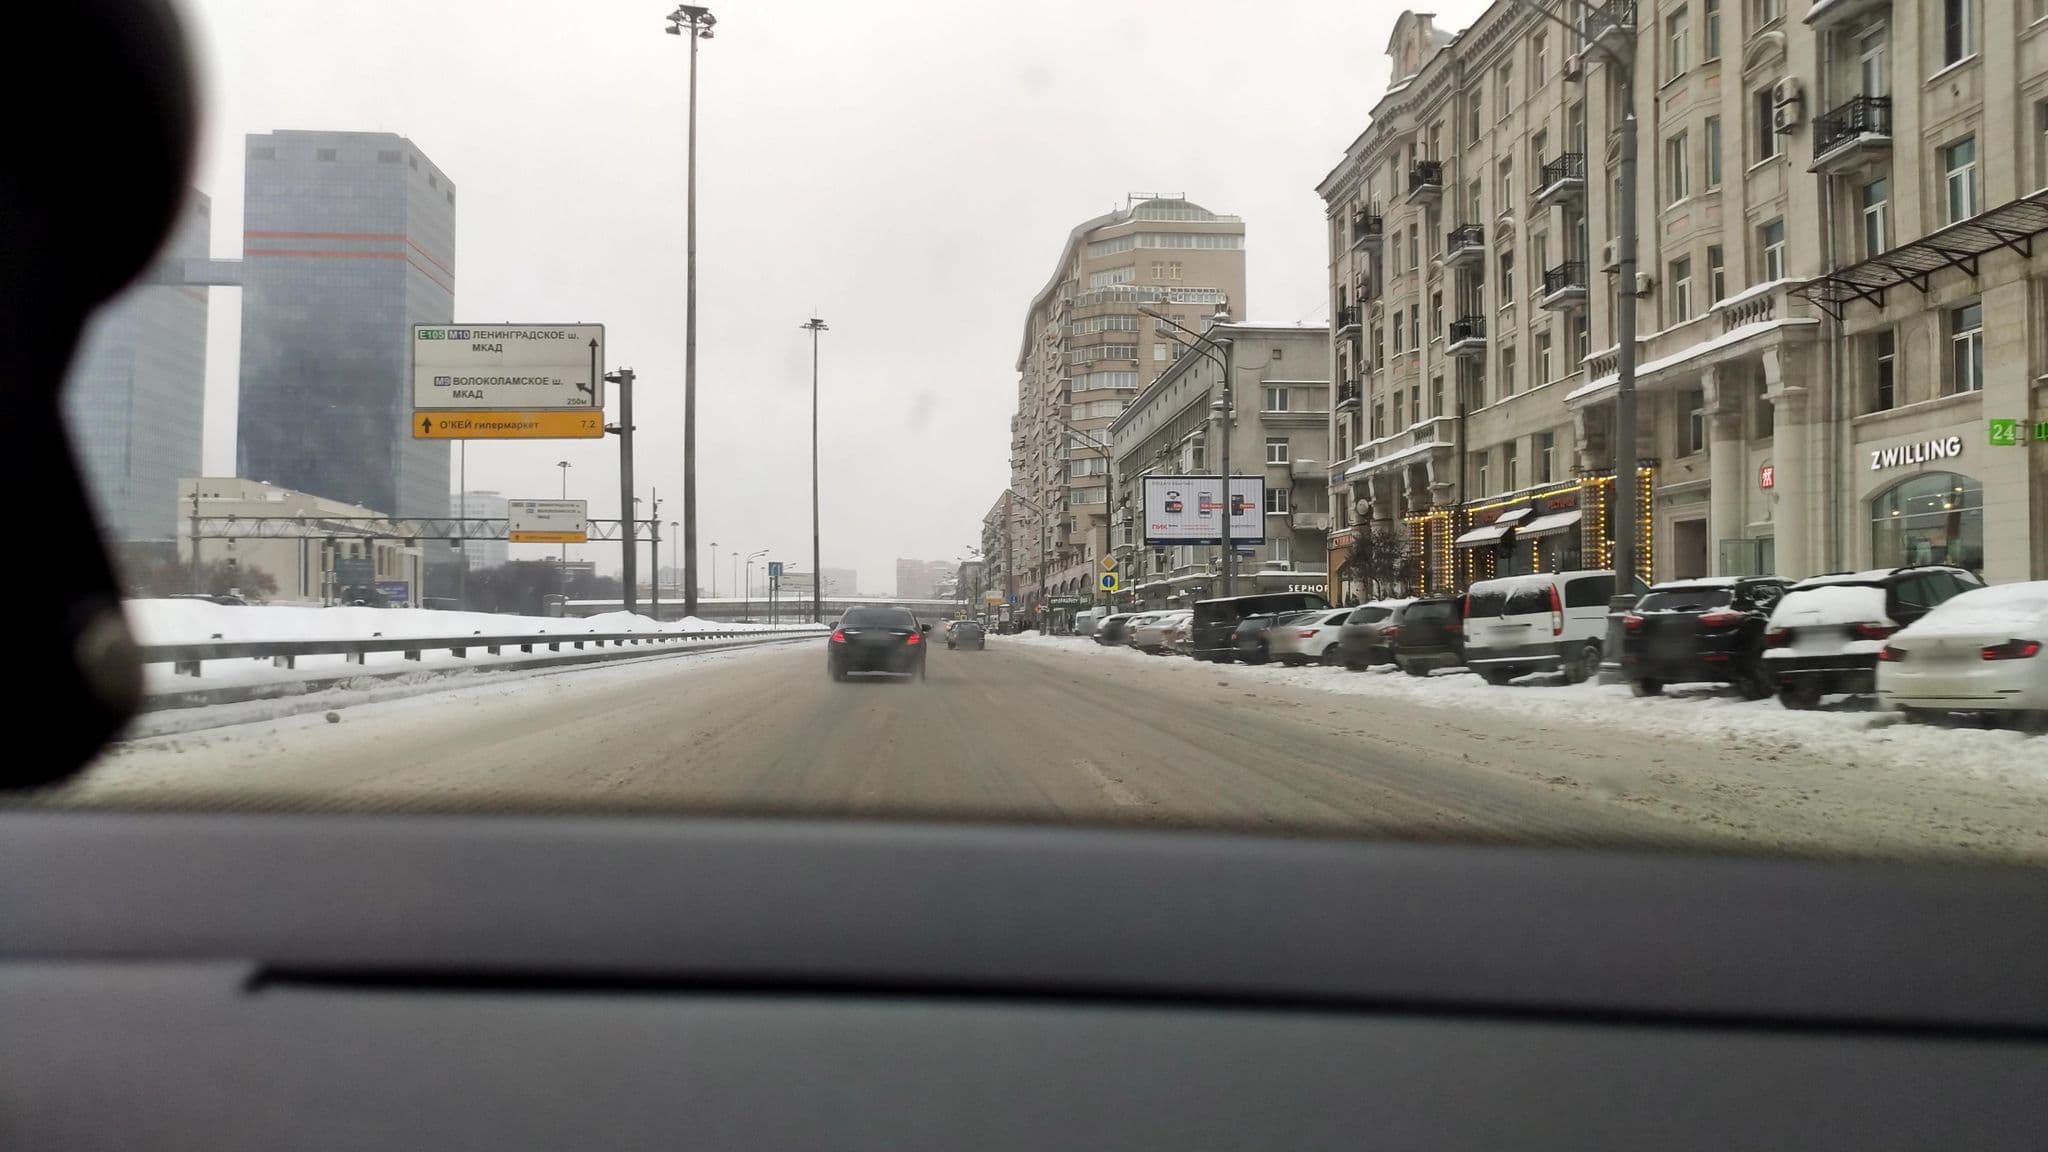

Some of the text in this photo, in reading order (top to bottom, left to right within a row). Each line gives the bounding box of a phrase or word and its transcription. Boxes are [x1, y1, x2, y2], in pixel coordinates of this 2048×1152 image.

[449, 330, 470, 339] М10
[472, 331, 565, 340] ЛЕНИНГРАДСКОЕ
[472, 344, 503, 353] МКАД
[452, 377, 549, 386] ВОЛОКОЛАМСКОЕ
[452, 390, 483, 399] МКАД
[439, 420, 472, 429] О'КЕЙ
[474, 421, 540, 431] гипермаркет
[1992, 424, 2015, 440] 24
[1870, 436, 1962, 471] ZWILLING
